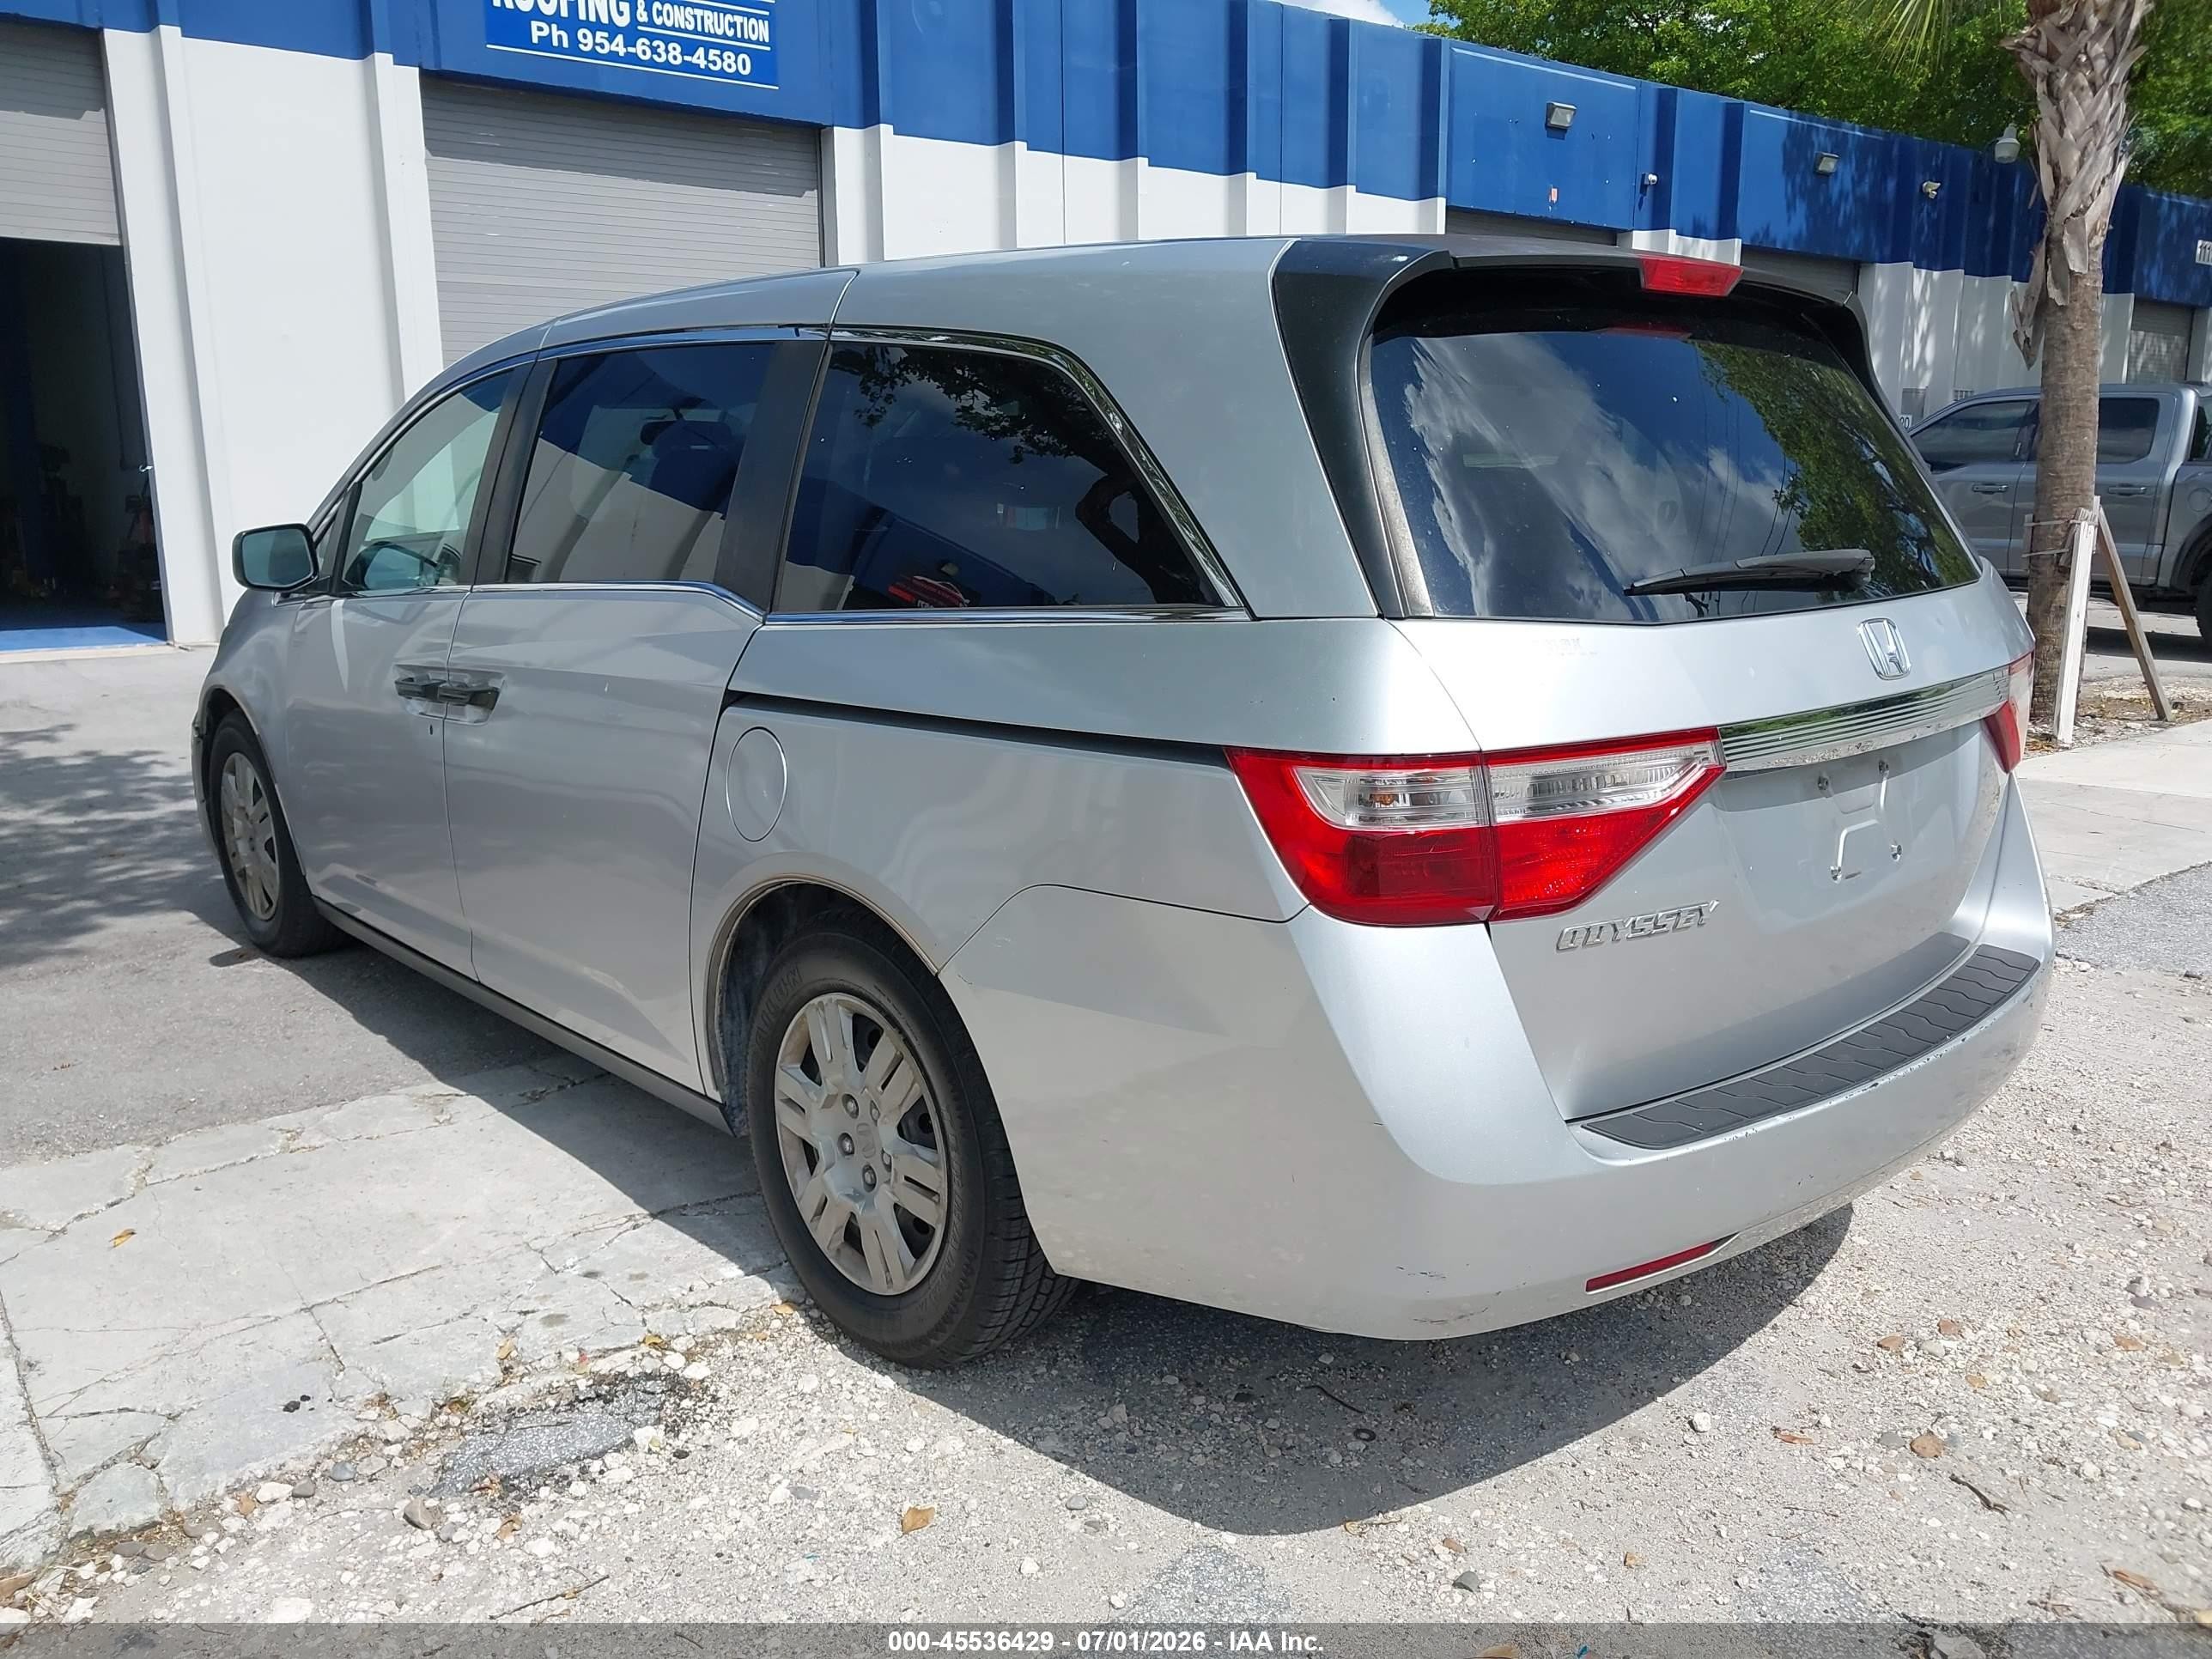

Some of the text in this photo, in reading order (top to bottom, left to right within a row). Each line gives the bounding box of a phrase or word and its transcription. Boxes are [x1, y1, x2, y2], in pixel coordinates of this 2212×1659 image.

[530, 20, 752, 76] Ph 954-638-4580
[636, 0, 649, 23] &
[652, 1, 770, 43] CONSTRUCTION
[1556, 899, 1720, 952] ODYSSEY
